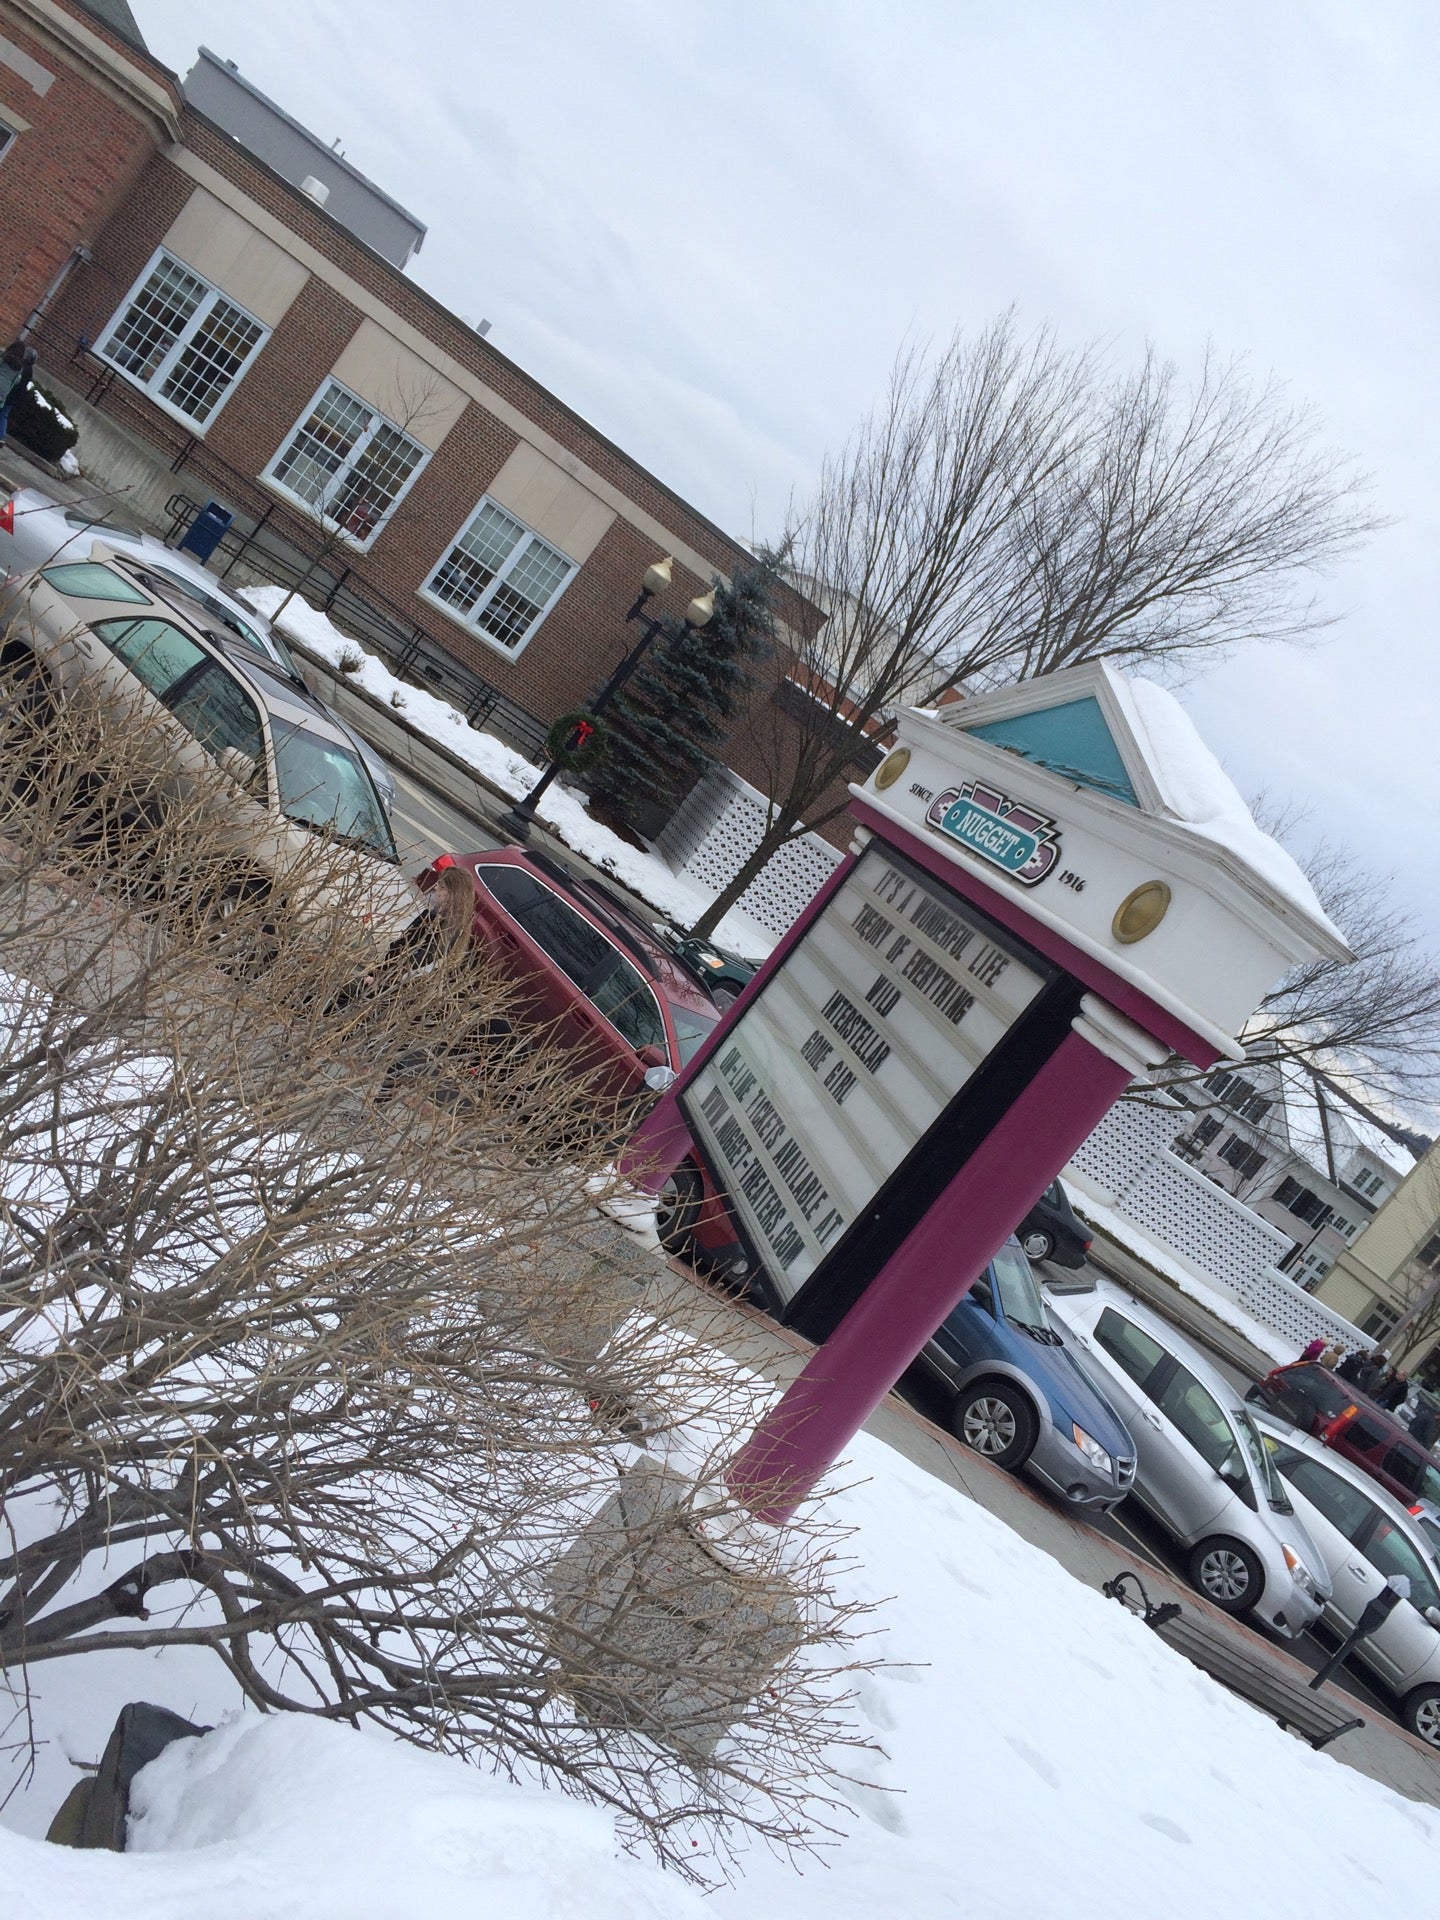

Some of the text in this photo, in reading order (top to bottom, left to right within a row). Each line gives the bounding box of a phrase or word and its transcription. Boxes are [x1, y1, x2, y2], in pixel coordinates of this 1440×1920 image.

[909, 783, 934, 803] SINCE
[955, 809, 1021, 858] NUGGET
[1057, 870, 1087, 893] 1916
[851, 902, 975, 1026] THEORY OF EVERYTHING
[873, 869, 1010, 988] IT'S A WONDERFUL LIFE
[821, 989, 891, 1075] INTERSTELLAR
[865, 974, 901, 1018] WILD
[800, 1029, 857, 1105] GONE GIRL
[701, 1084, 806, 1271] WWW.NUGGET-THEATERS.COM
[720, 1047, 844, 1245] ON-LINE TICKETS AVAILABLE AT
